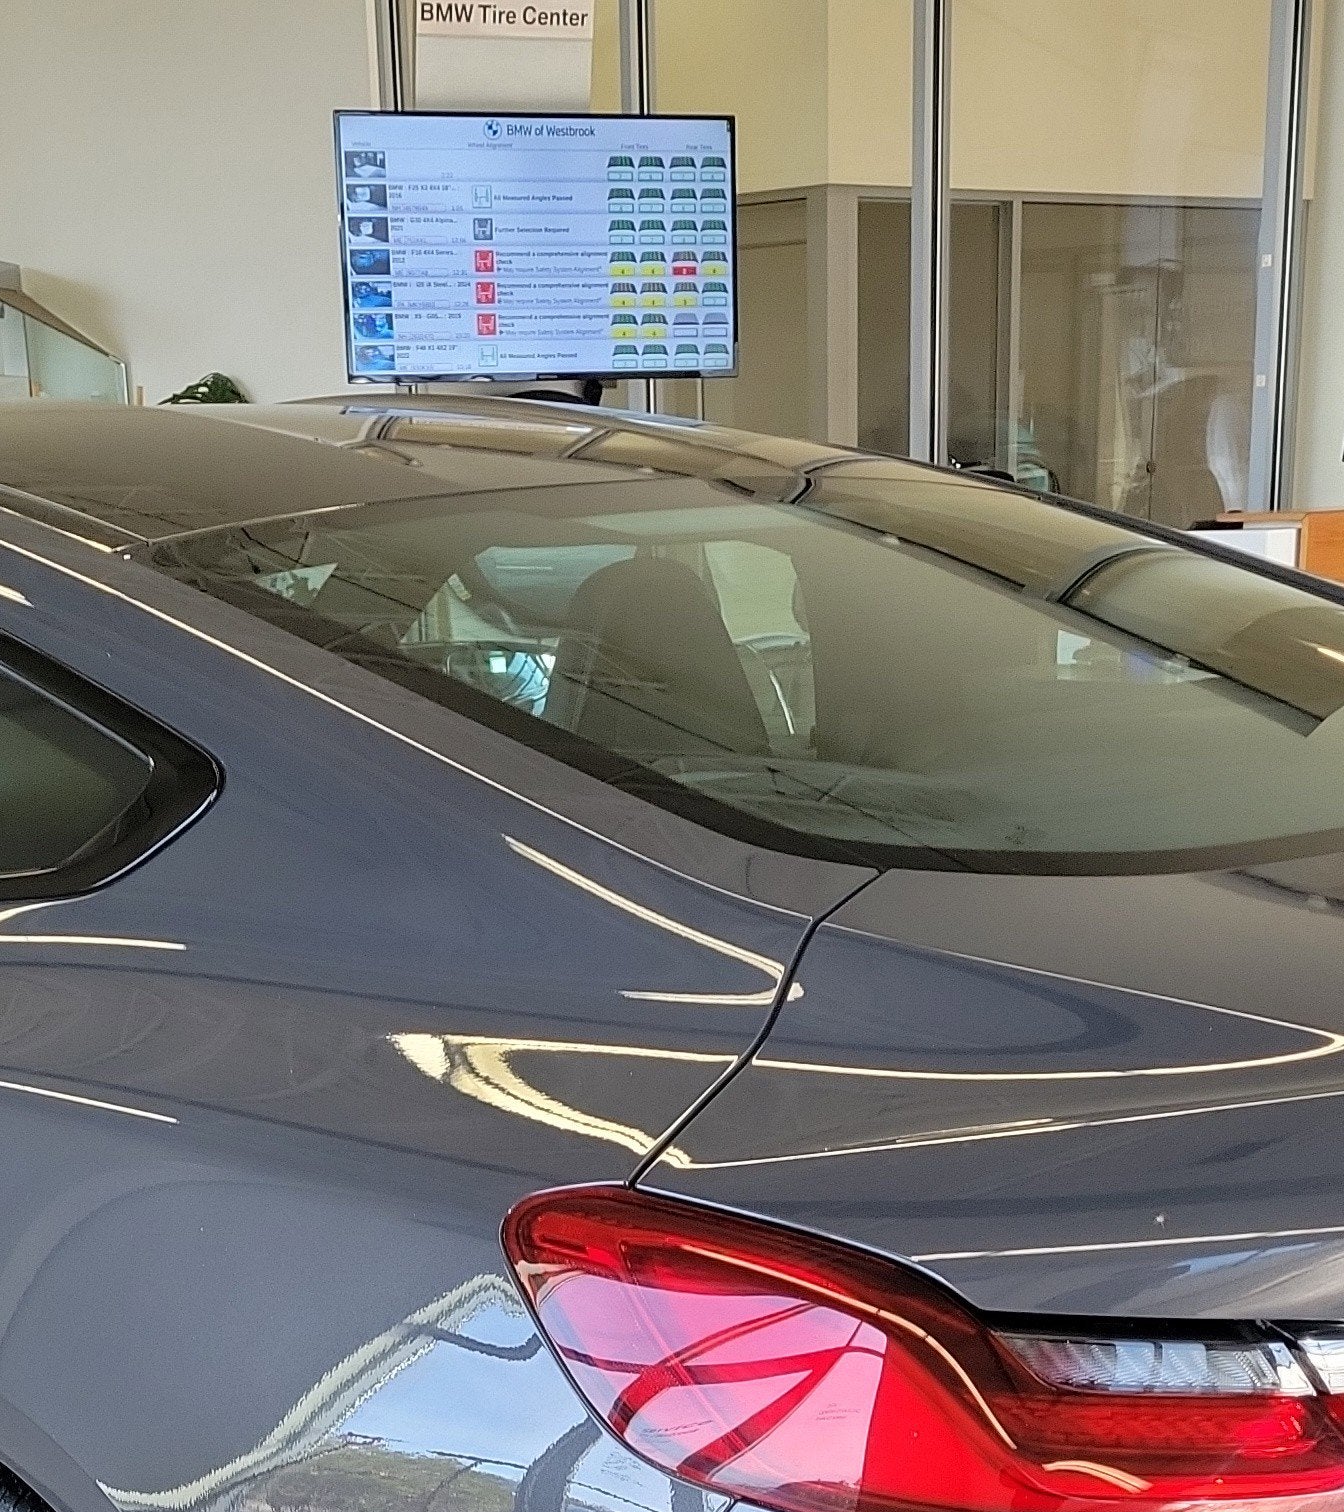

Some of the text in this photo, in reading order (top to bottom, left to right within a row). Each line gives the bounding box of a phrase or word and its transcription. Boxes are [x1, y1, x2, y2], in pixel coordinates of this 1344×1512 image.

[420, 2, 588, 26] BMW Tire Center
[506, 124, 596, 137] BMW of Westbrook
